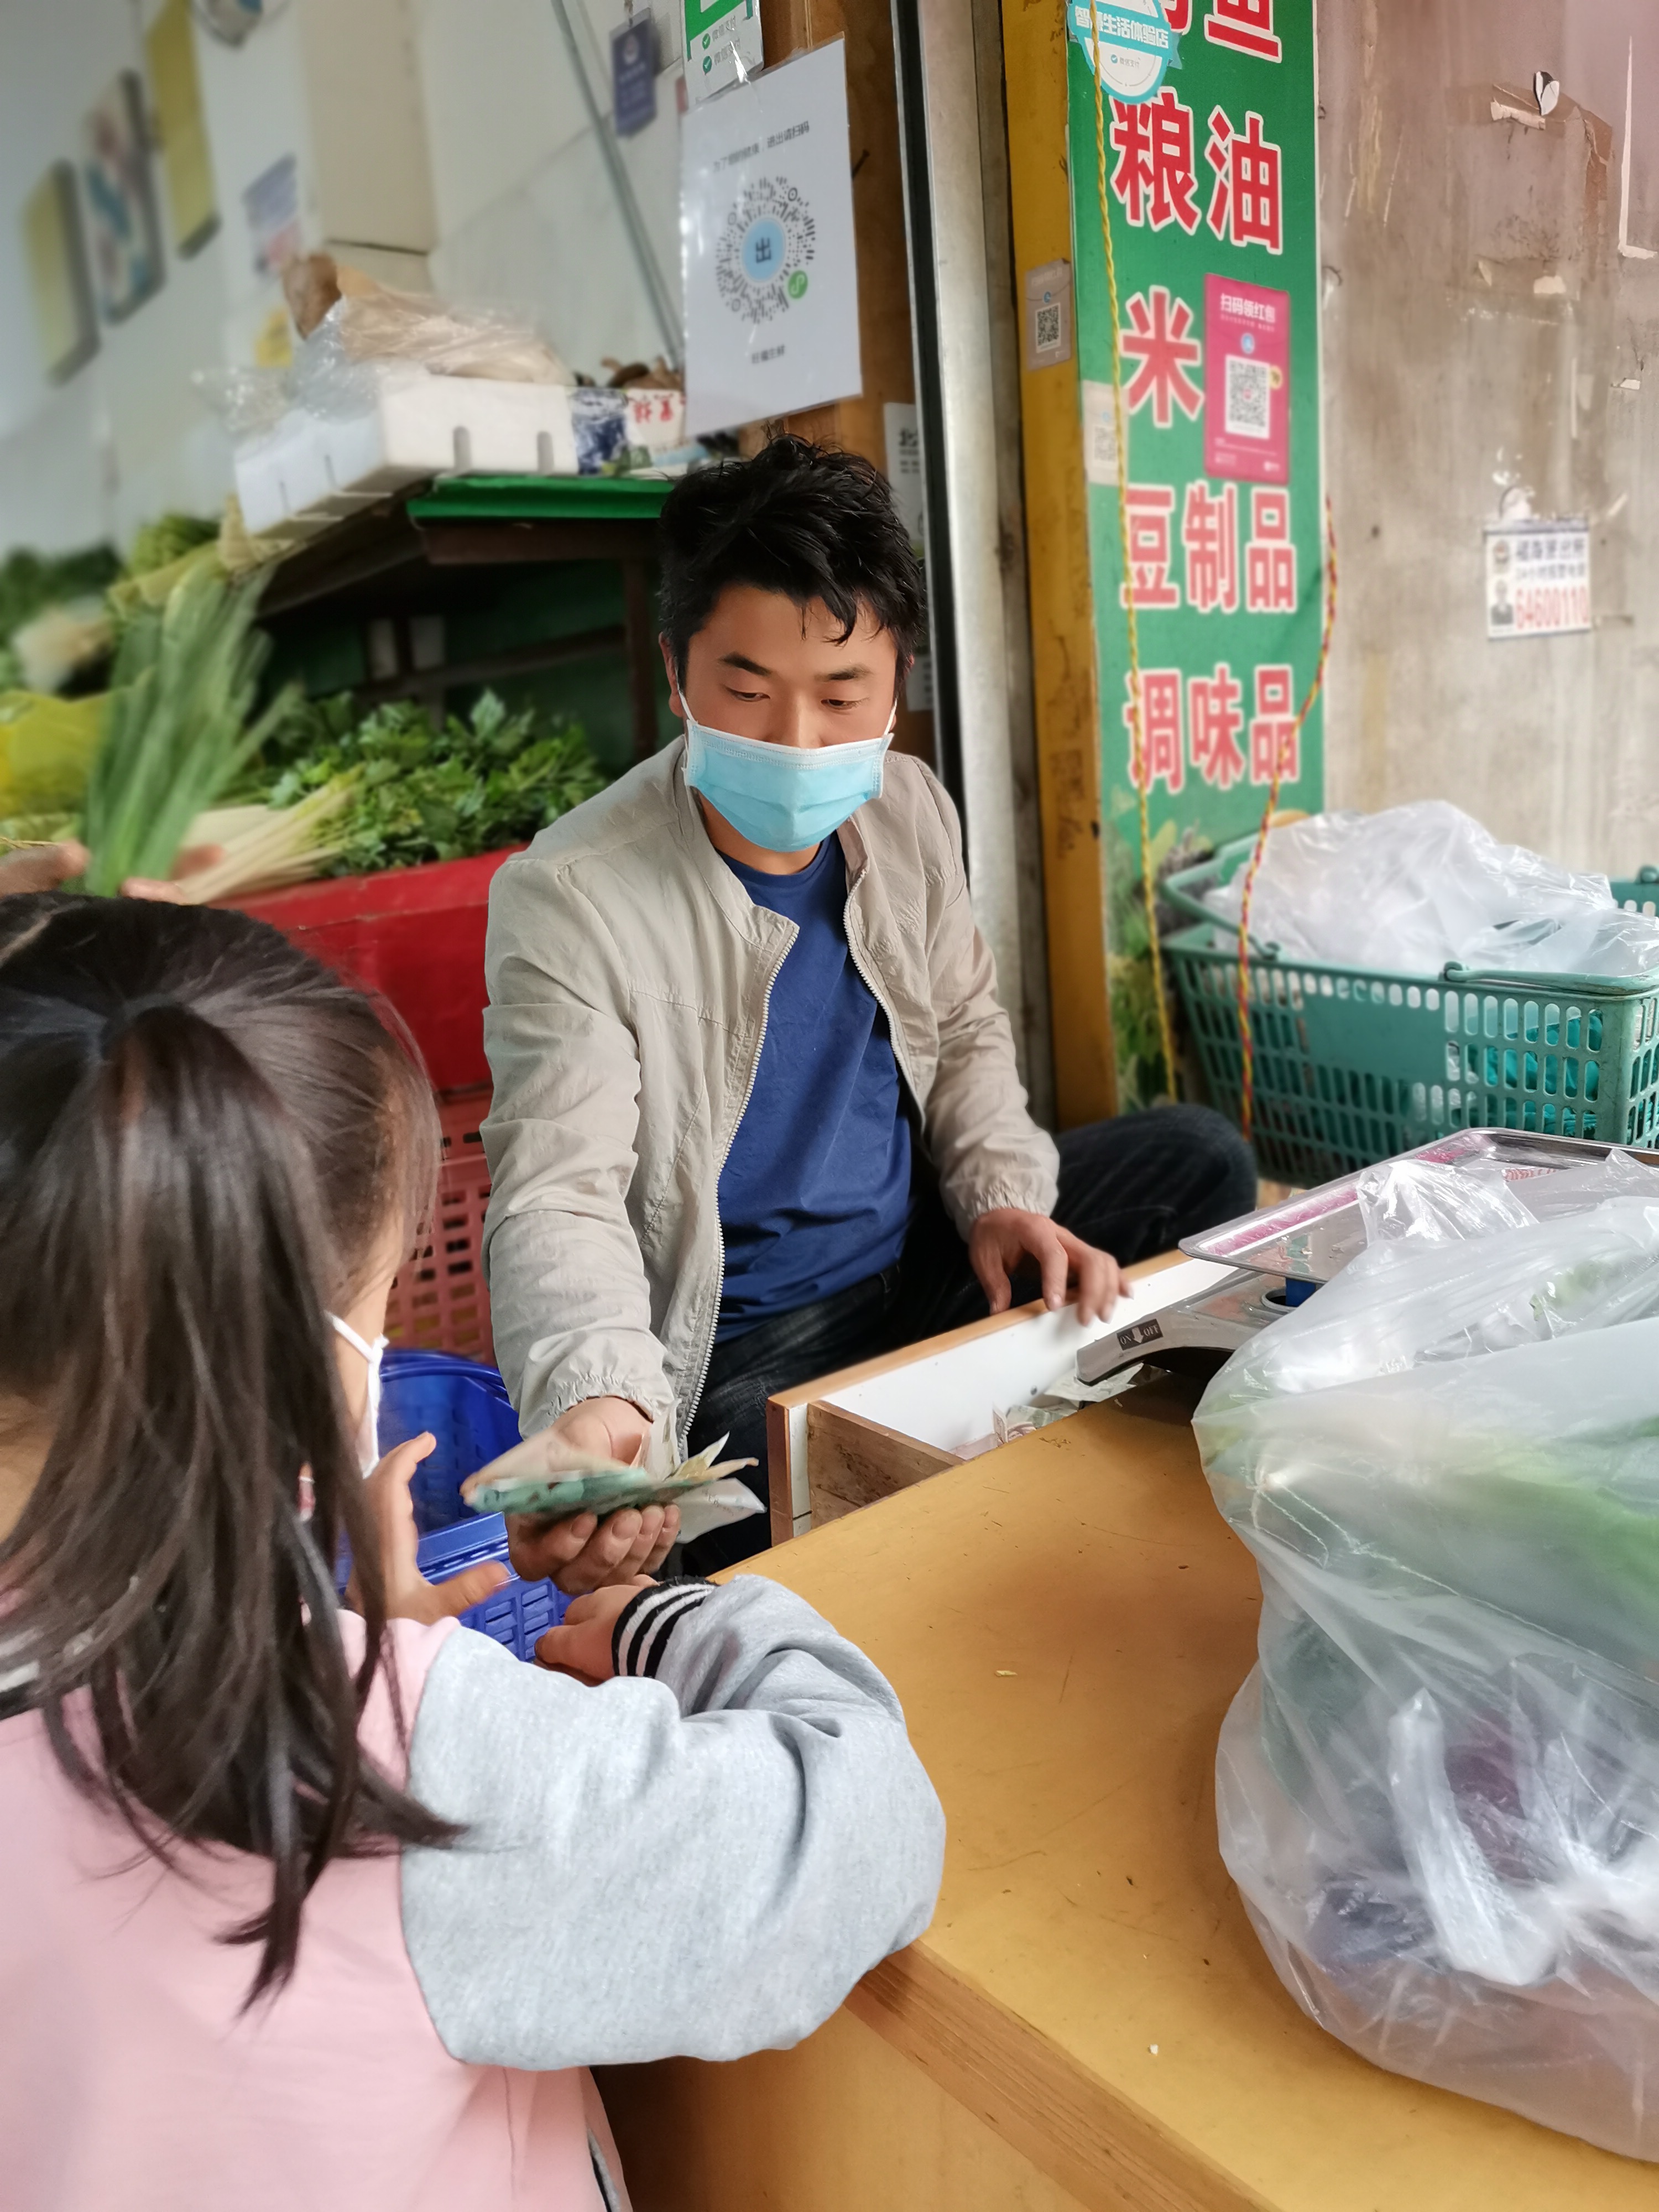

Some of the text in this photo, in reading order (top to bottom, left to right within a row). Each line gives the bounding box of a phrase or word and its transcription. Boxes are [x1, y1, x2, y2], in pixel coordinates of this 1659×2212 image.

[1109, 87, 1283, 254] 粮油
[755, 236, 773, 264] 出
[1220, 293, 1276, 324] 扫码领红包
[1118, 285, 1206, 429] 米
[1120, 480, 1297, 614] 豆制品
[1123, 662, 1301, 794] 调味品
[1119, 1324, 1159, 1345] ON OFF
